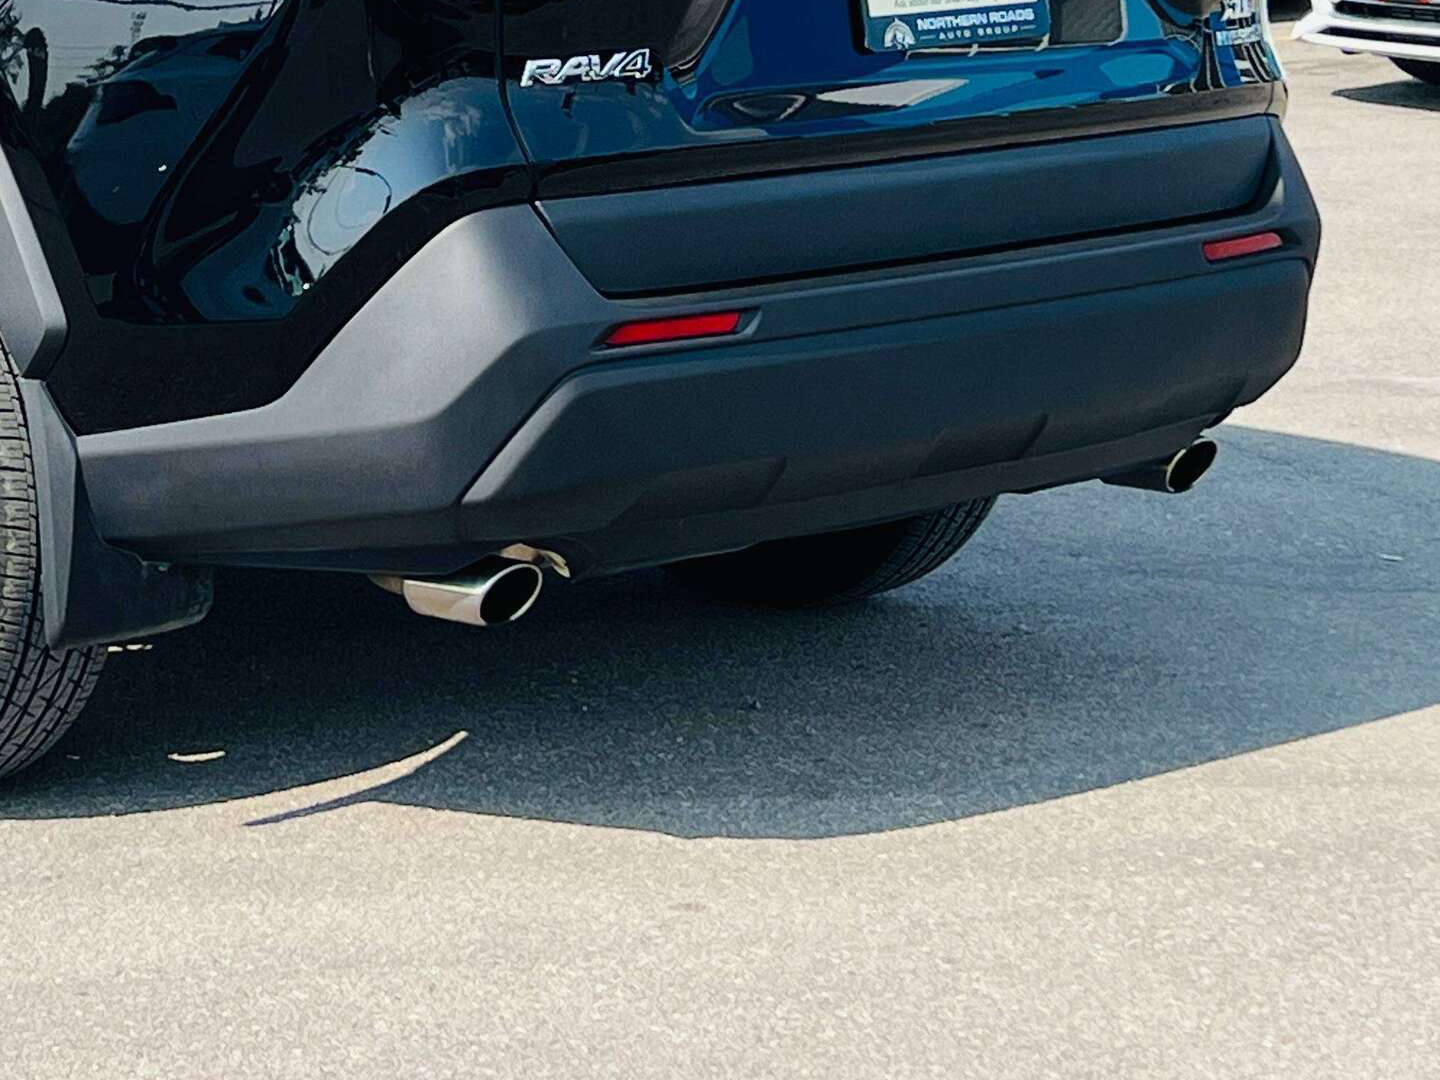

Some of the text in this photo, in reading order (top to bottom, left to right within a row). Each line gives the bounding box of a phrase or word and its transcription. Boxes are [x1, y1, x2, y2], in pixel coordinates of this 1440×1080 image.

[916, 7, 1036, 32] NORTHERN ROADS
[938, 24, 1019, 40] AUTO GROUP
[520, 47, 653, 88] RAV4
